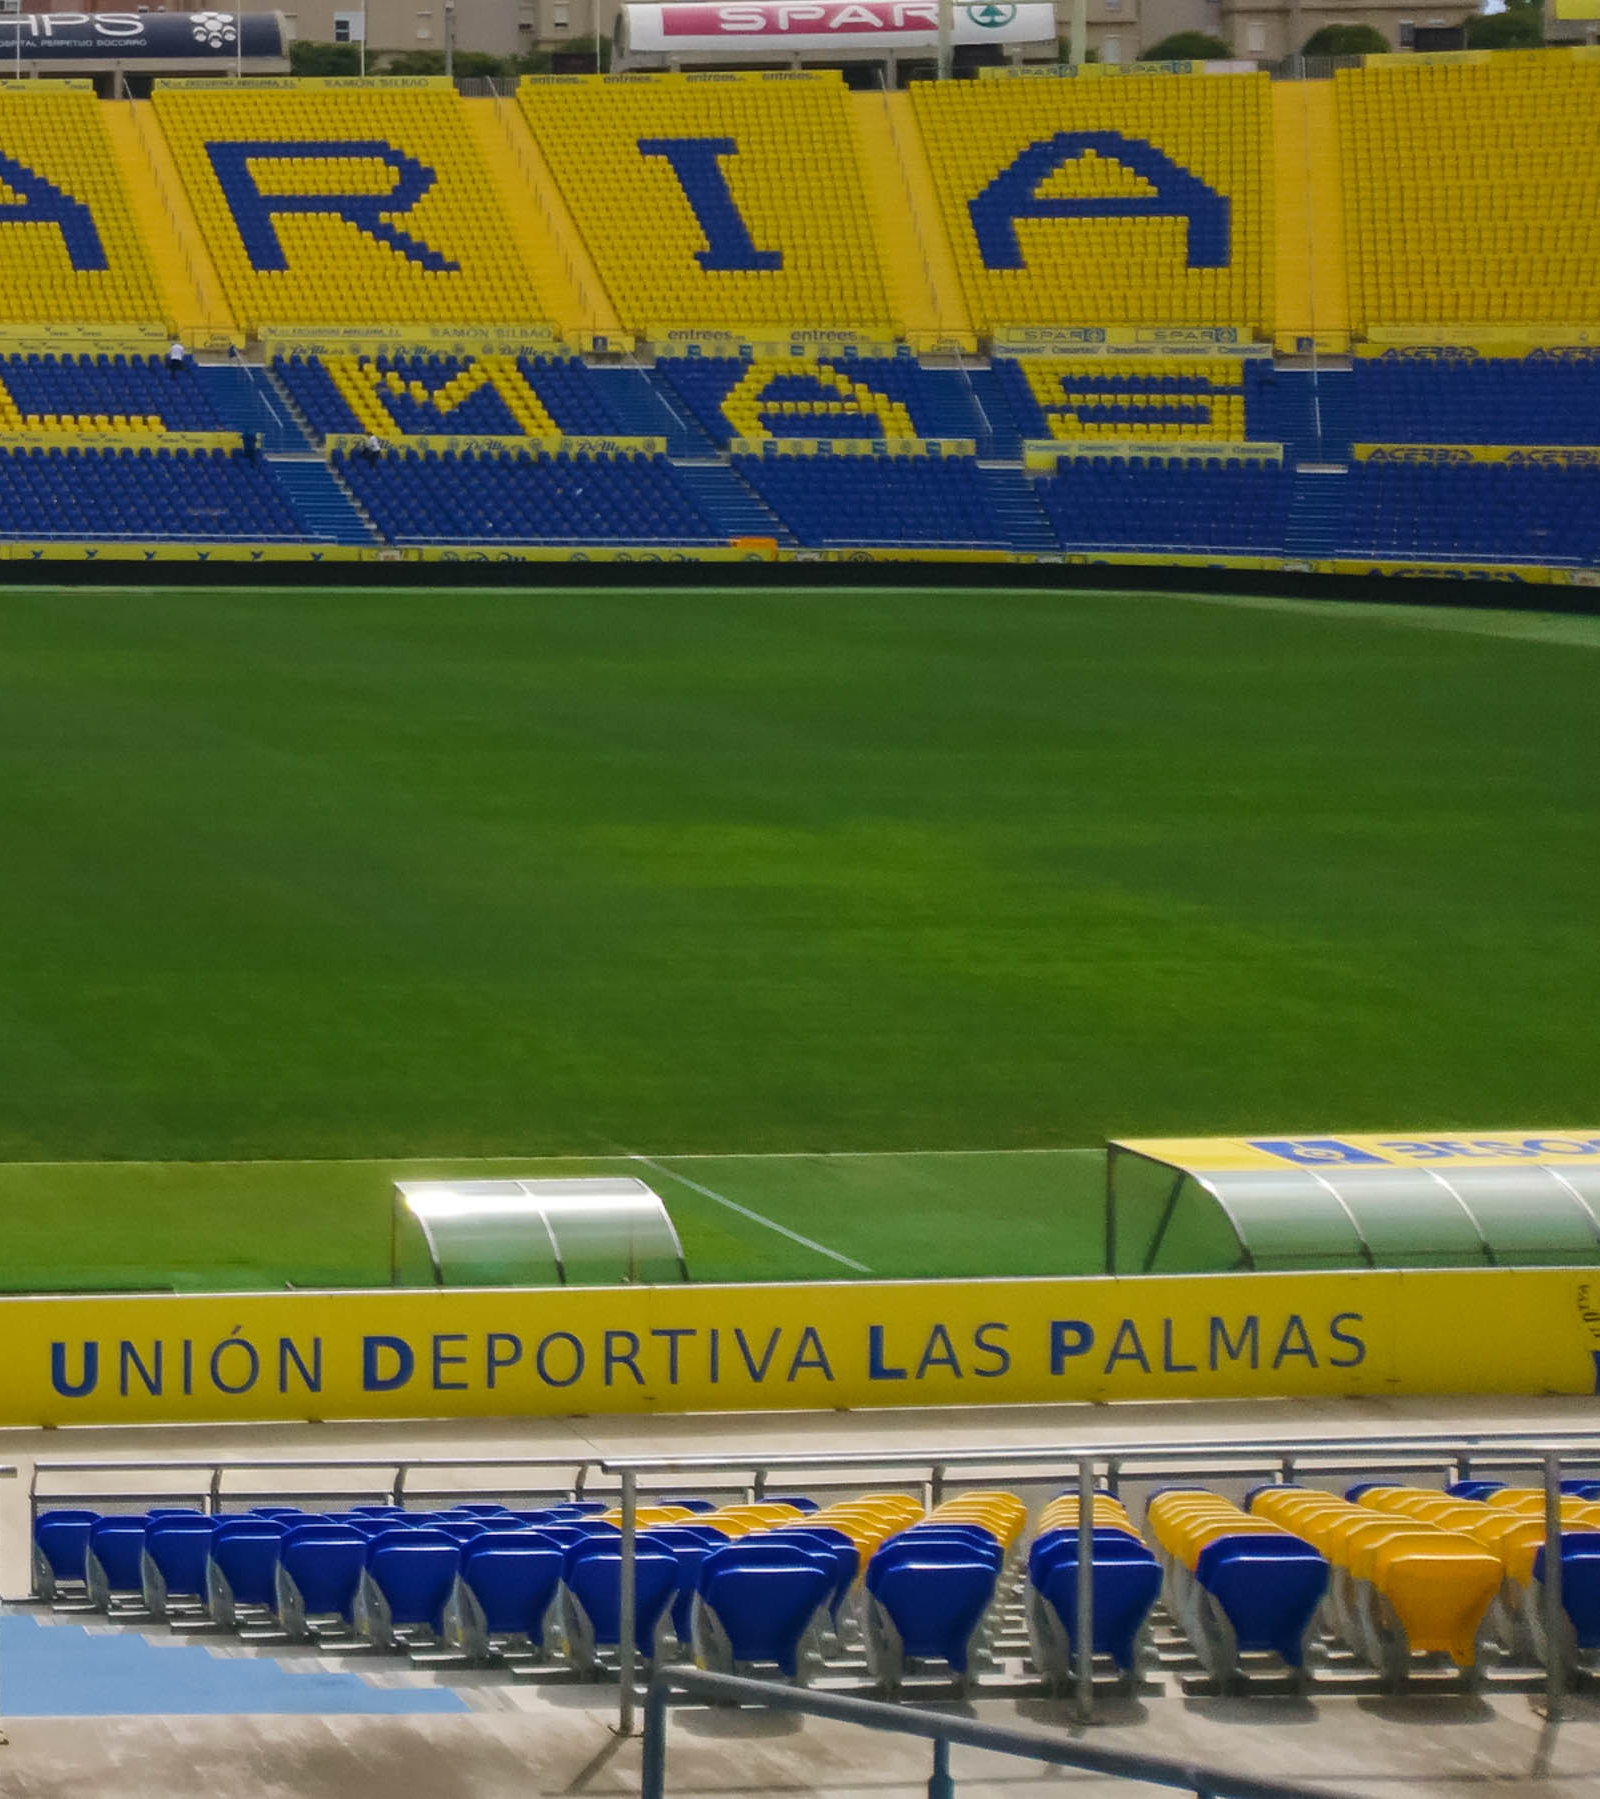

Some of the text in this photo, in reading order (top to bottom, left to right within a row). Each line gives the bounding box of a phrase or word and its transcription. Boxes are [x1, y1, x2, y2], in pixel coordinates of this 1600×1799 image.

[718, 2, 940, 32] SPAR
[51, 1312, 1367, 1398] UNIÓN DEPORTIVA LAS PALMAS
